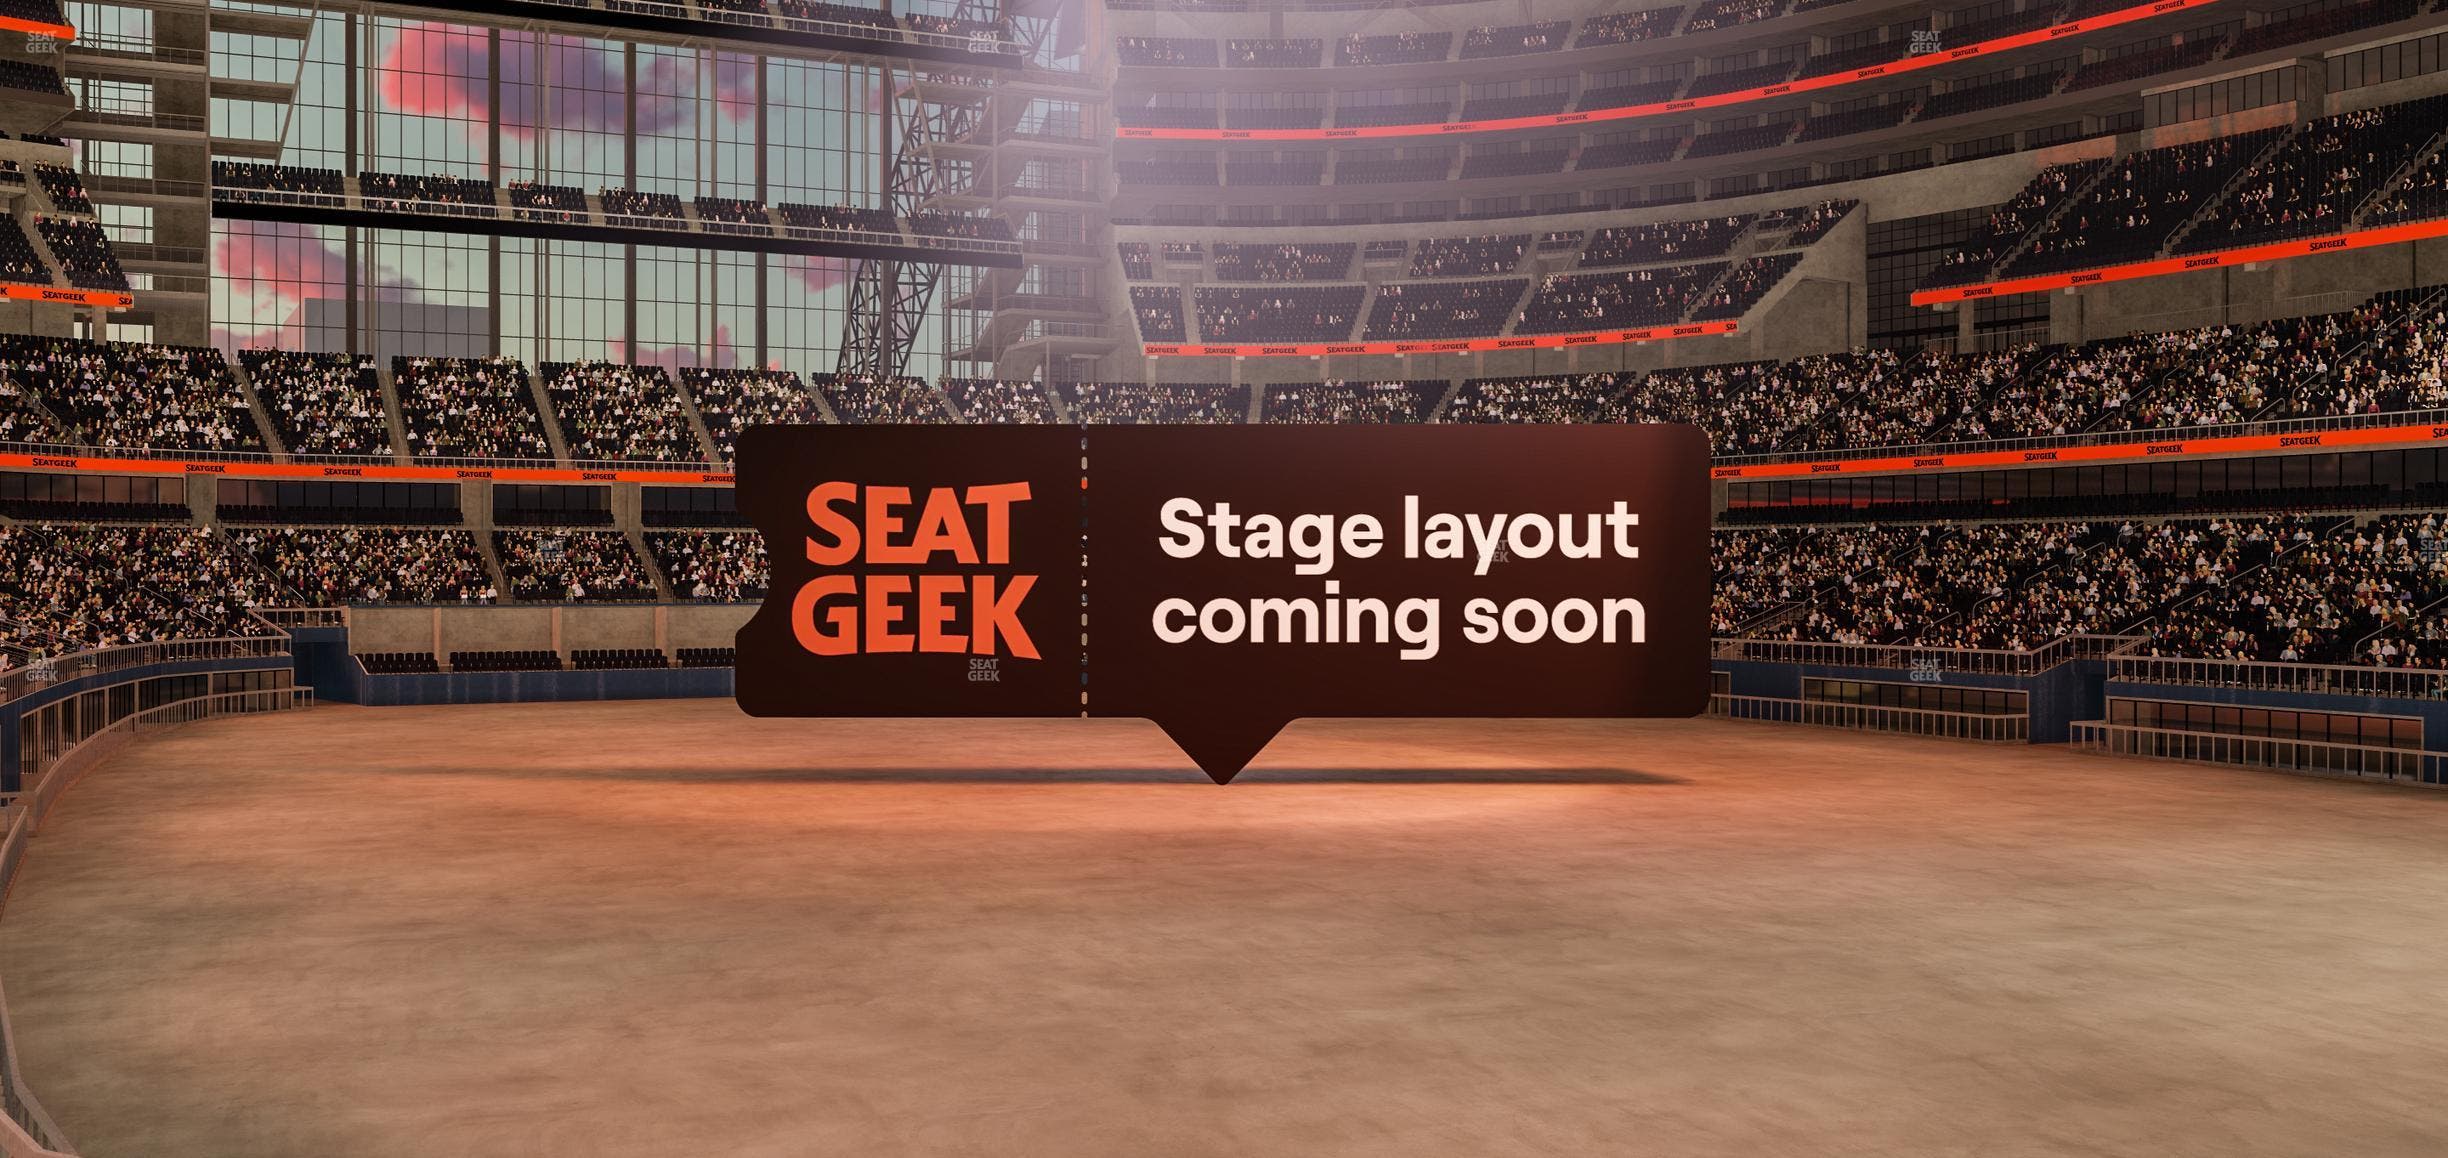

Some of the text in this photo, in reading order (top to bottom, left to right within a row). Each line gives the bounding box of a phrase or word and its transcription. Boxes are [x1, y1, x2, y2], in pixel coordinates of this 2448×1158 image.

[2310, 238, 2347, 252] SEATGEEK
[2185, 256, 2219, 269] SEATGEEK
[2071, 272, 2102, 283] SEATGEEK
[42, 290, 86, 302] SEATGEEK
[1963, 287, 1993, 297] SEATGEEK
[2280, 435, 2321, 447] SEATGEEK
[2146, 444, 2183, 454] SEATGEEK
[2024, 451, 2057, 461] SEATGEEK
[32, 458, 77, 469] SEATGEEK
[1913, 458, 1944, 467] SEATGEEK
[185, 464, 226, 473] SEATGEEK
[324, 468, 362, 477] SEATGEEK
[1714, 469, 1741, 477] SEATGEEK
[1811, 464, 1840, 472] SEATGEEK
[456, 470, 492, 479] SEATGEEK
[582, 473, 617, 481] SEATGEEK
[806, 481, 1032, 566] SEAT
[1158, 495, 1639, 576] Stage layout
[791, 575, 1042, 660] GEEK
[1152, 580, 1645, 660] coming soon
